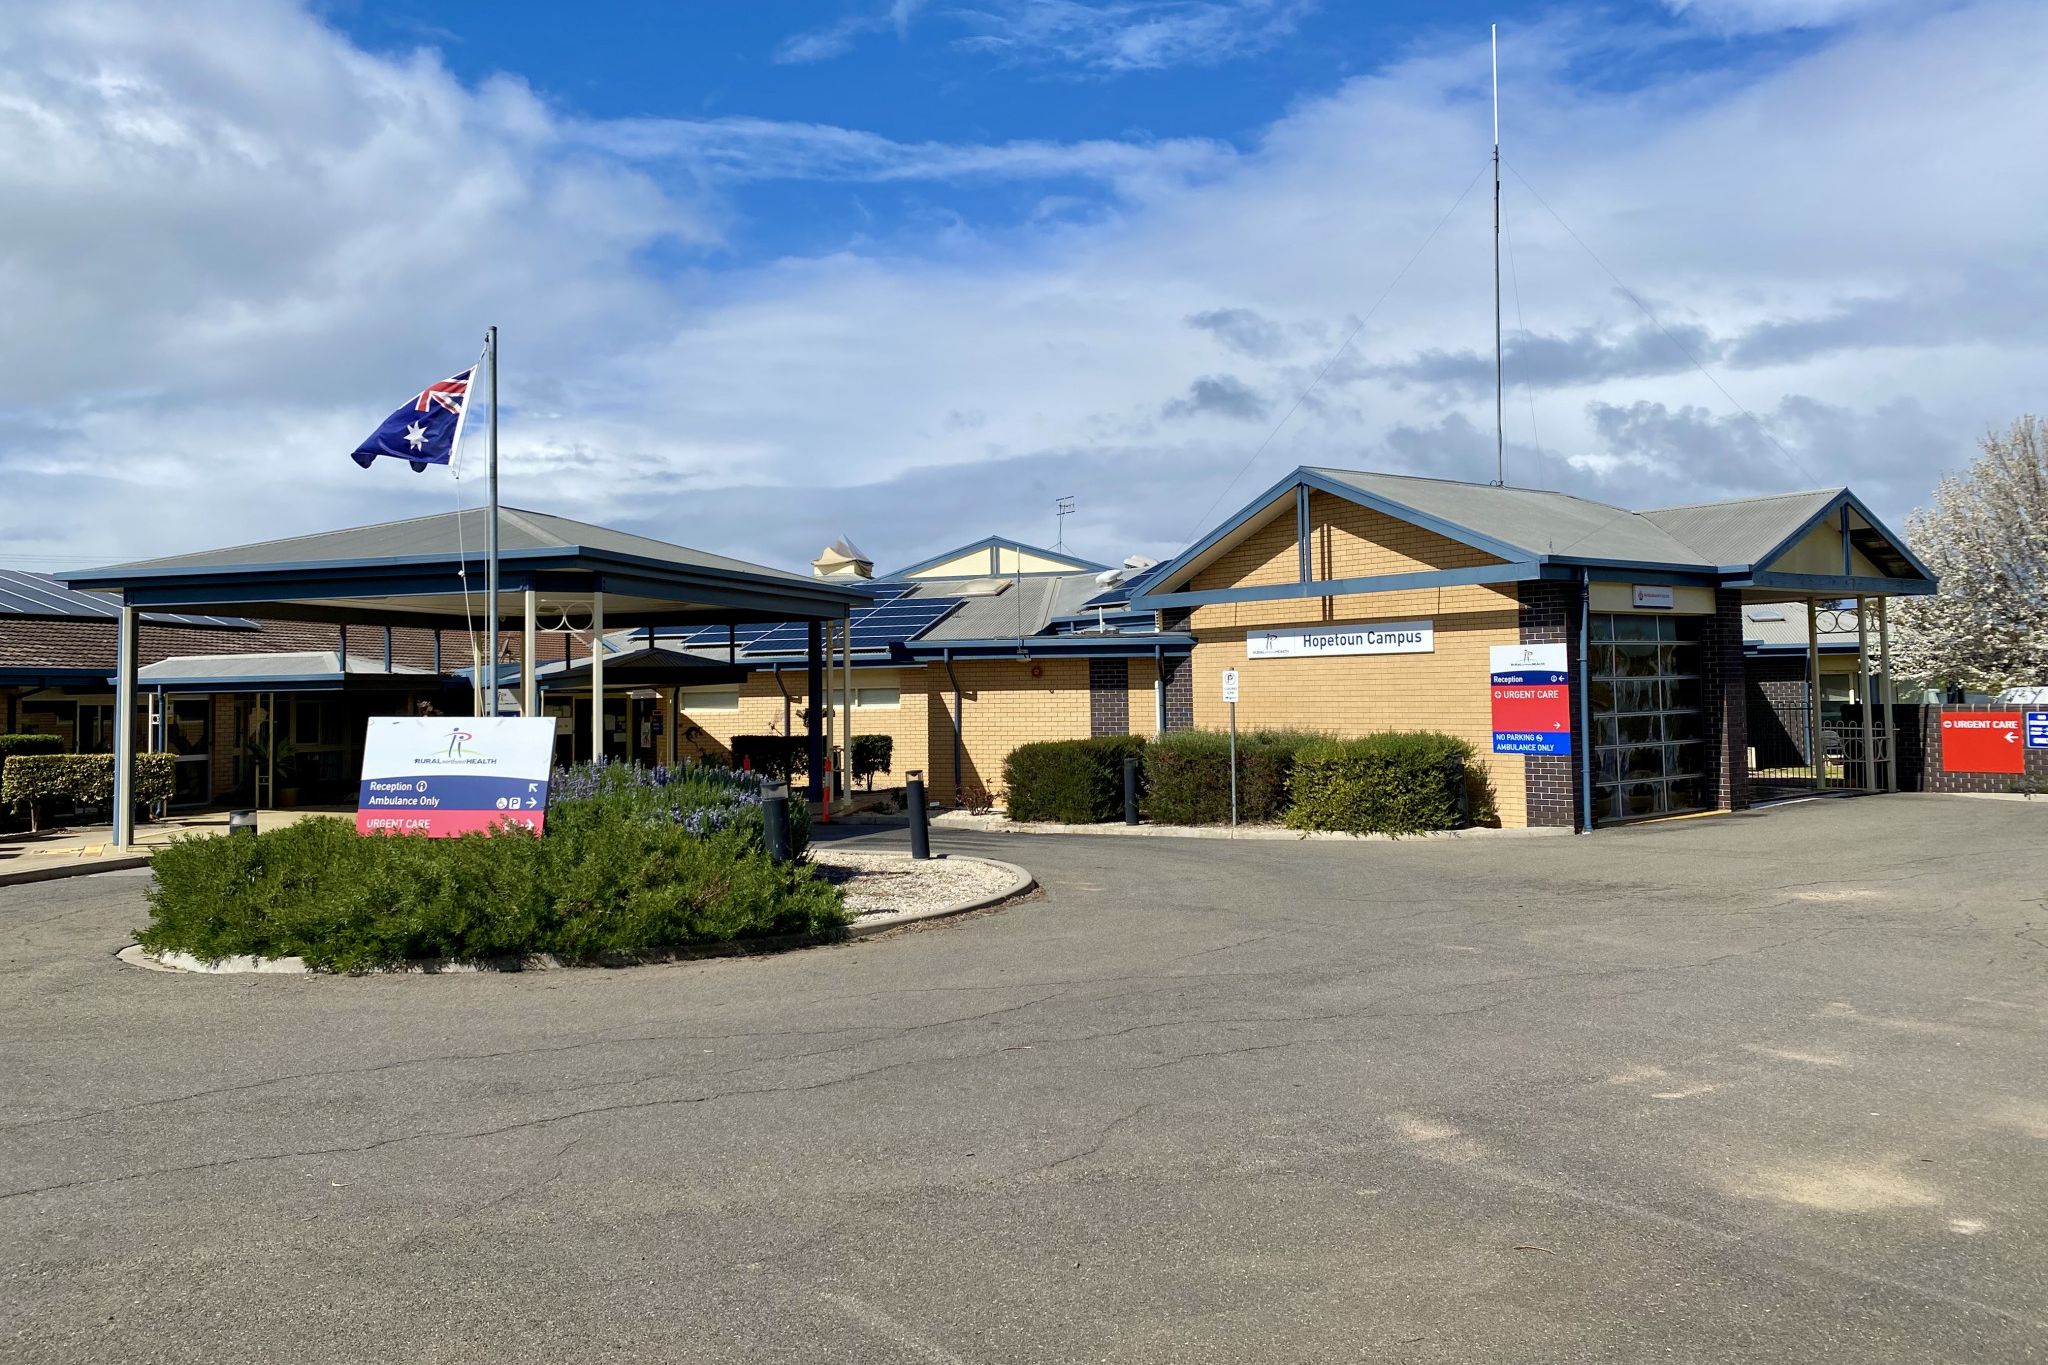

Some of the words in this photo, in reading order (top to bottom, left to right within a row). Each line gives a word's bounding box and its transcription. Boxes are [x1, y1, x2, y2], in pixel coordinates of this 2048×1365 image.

[1303, 634, 1363, 650] Hopetoun
[1367, 631, 1422, 646] Campus
[1493, 675, 1523, 684] Reception
[1503, 690, 1535, 698] URGENT
[1537, 690, 1559, 698] CARE
[1954, 720, 1991, 728] URGENT
[1992, 720, 2018, 728] CARE
[369, 781, 412, 793] Reception
[368, 796, 418, 806] Ambulance
[420, 796, 440, 807] Only
[366, 819, 404, 828] URGENT
[405, 819, 431, 829] CARE
